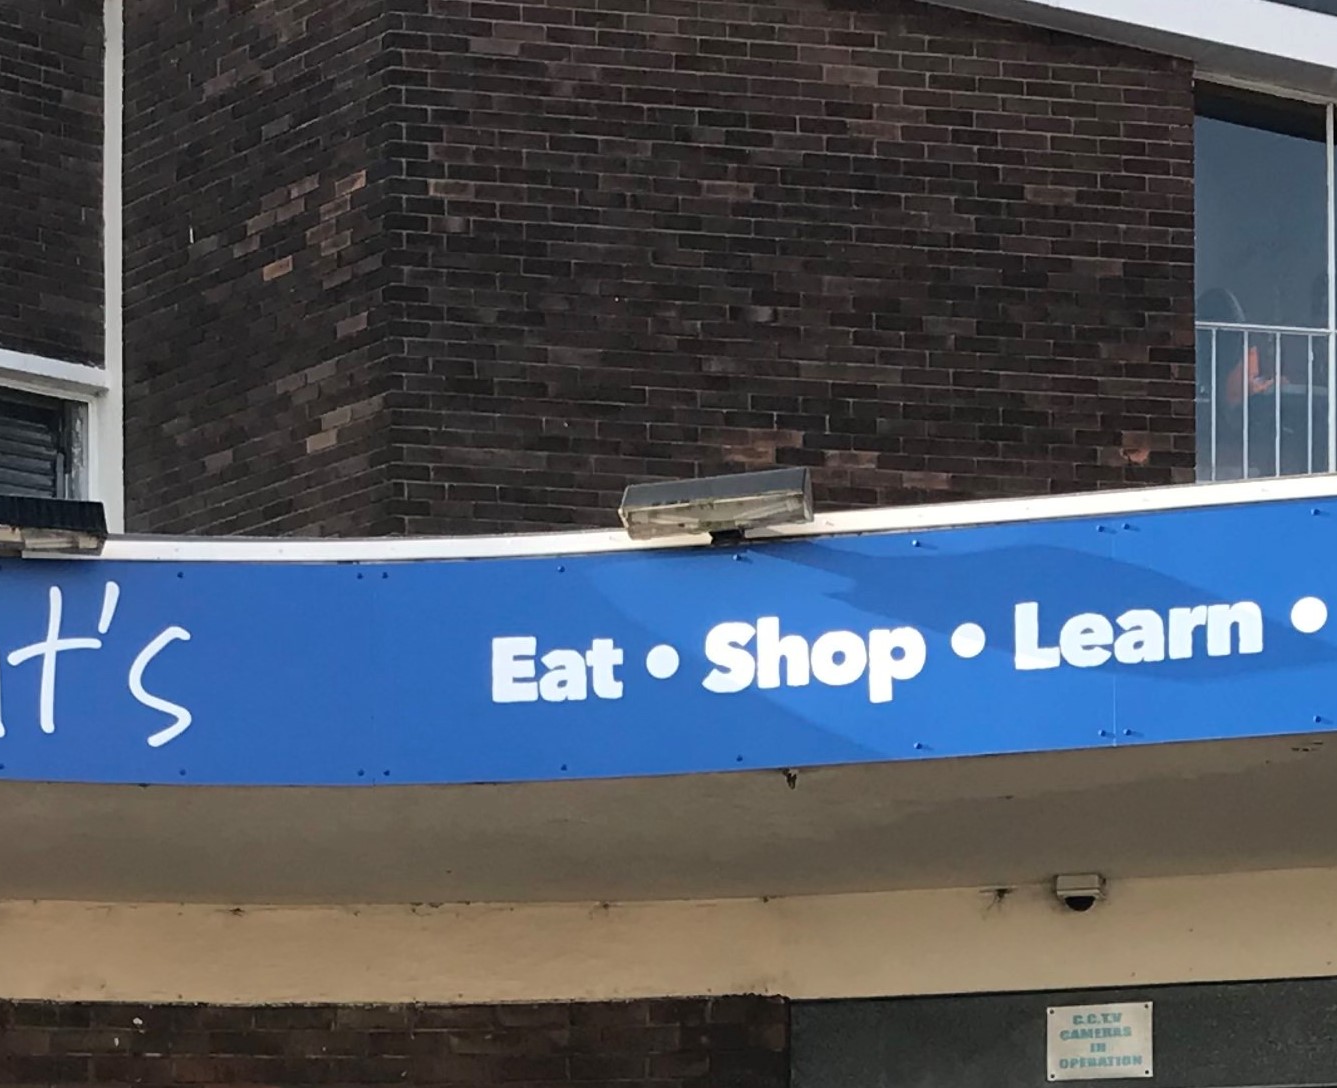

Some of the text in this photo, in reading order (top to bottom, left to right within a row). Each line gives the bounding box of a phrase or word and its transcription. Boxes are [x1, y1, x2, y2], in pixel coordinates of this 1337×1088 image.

[490, 636, 624, 703] Eat
[701, 615, 927, 704] Shop
[1014, 600, 1265, 671] Learn
[1060, 1026, 1132, 1040] CAMERAS
[1059, 1055, 1143, 1069] OPERATION
